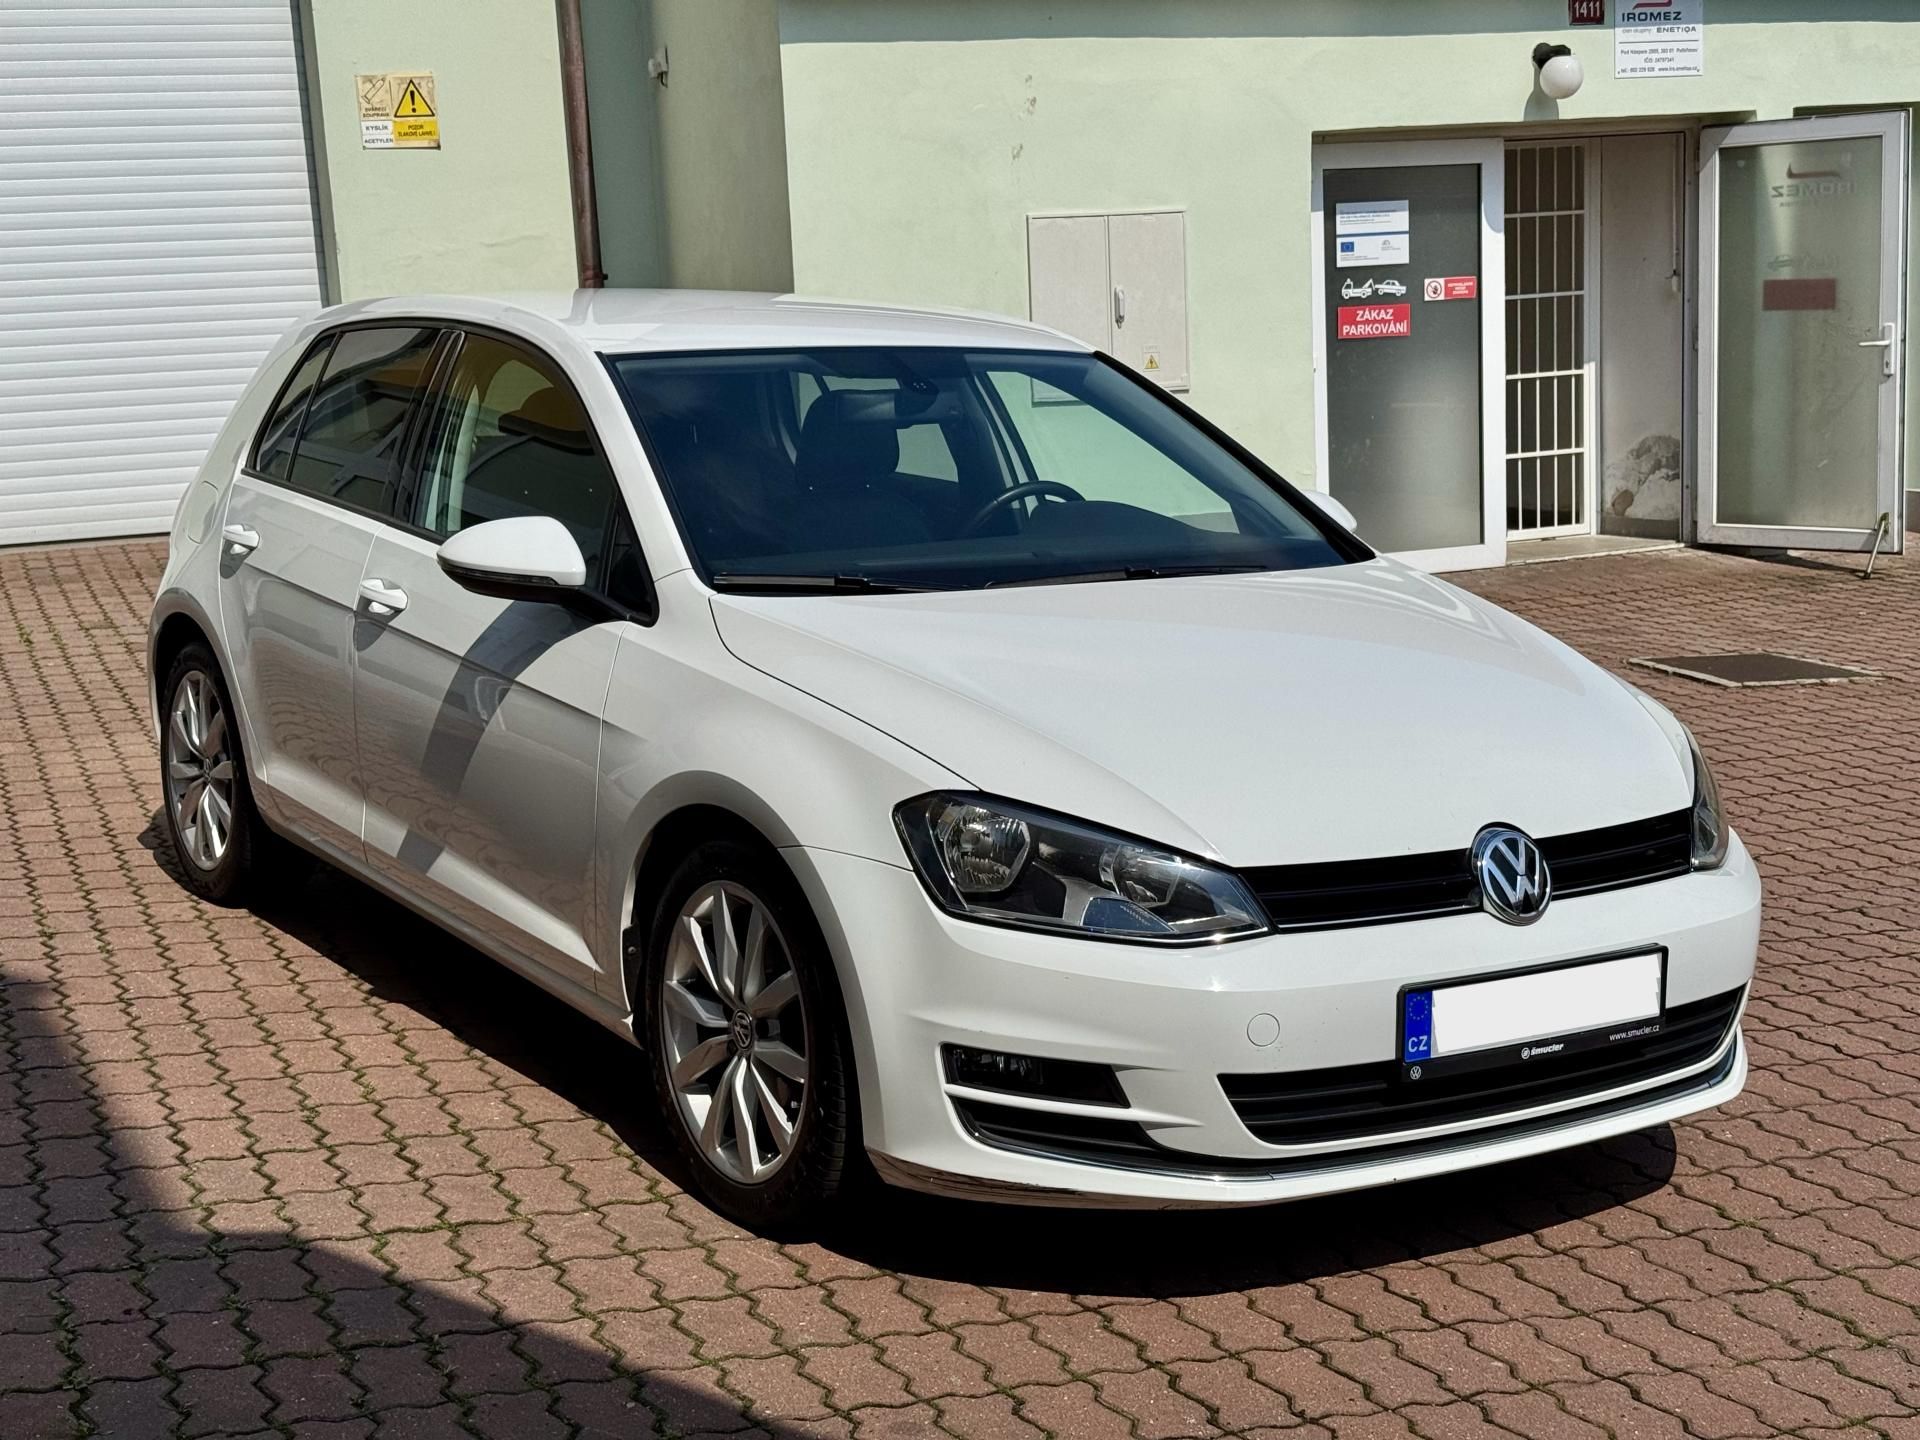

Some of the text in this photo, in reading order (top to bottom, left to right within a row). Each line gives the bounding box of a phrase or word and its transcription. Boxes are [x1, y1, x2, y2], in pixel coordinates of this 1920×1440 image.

[1574, 1, 1600, 18] 1411
[1621, 11, 1682, 22] IROMEZ
[1656, 26, 1697, 35] ENETIQA
[1356, 308, 1394, 321] ZÁKAZ
[1342, 319, 1408, 336] PARKOVÁNÍ
[1609, 1024, 1660, 1042] www.smucler.cz
[1408, 1035, 1428, 1053] CZ
